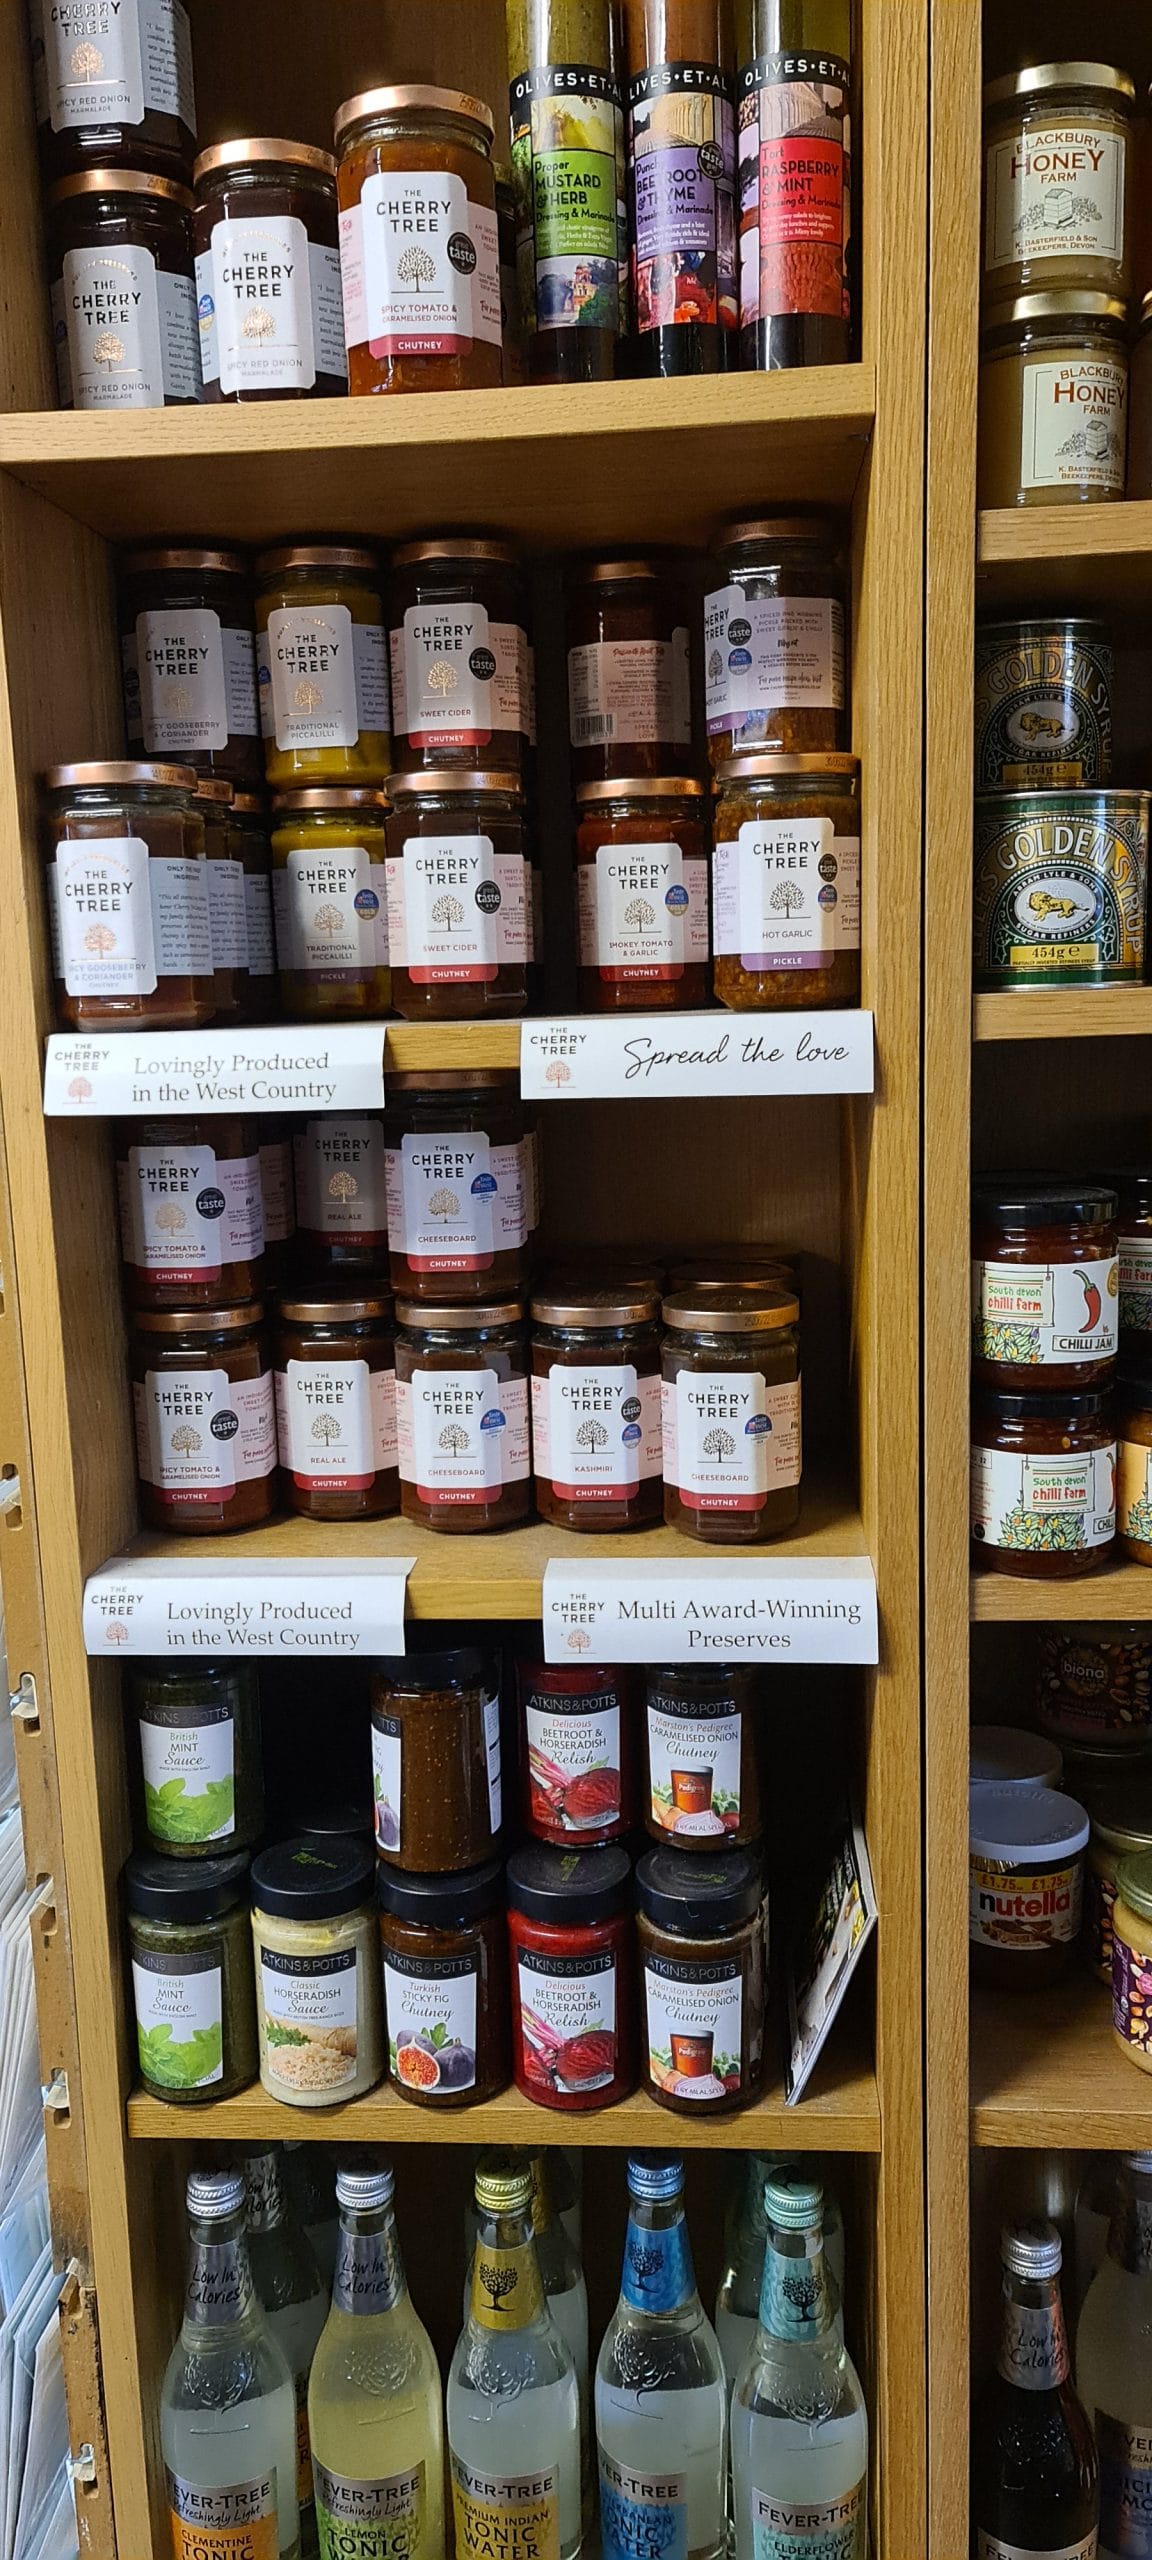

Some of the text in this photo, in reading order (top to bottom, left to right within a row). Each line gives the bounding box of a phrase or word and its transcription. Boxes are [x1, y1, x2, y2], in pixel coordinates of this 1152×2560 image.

[51, 1, 121, 22] CHERRY
[61, 20, 109, 37] TREE
[1017, 132, 1101, 154] BLACKBURY
[535, 161, 569, 175] Proper
[1011, 149, 1105, 179] HONEY
[535, 174, 601, 192] MUSTARD
[1041, 172, 1077, 184] FARM
[777, 178, 813, 192] MINT
[551, 191, 588, 205] HERB
[377, 201, 451, 216] CHERRY
[391, 219, 438, 232] TREE
[244, 253, 268, 262] THE
[450, 246, 476, 264] taste
[223, 265, 294, 283] CHERRY
[93, 280, 117, 290] THE
[235, 284, 281, 298] TREE
[73, 292, 141, 309] CHERRY
[85, 310, 129, 325] TREE
[102, 383, 151, 392] RED ONION
[1054, 382, 1125, 409] HONEY
[1083, 405, 1111, 416] FARM
[471, 660, 495, 670] taste
[987, 650, 1094, 695] GOLDEN
[286, 722, 340, 731] TRADITIONAL
[291, 731, 335, 739] PICCALILLI
[753, 840, 821, 855] CHERRY
[997, 826, 1114, 871] GOLDEN
[416, 858, 479, 871] CHERRY
[765, 856, 808, 870] TREE
[426, 873, 468, 885] TREE
[1043, 871, 1066, 879] LYLE
[65, 882, 133, 897] CHERRY
[476, 892, 500, 904] taste
[76, 900, 121, 913] TREE
[1110, 857, 1142, 954] SYRUP
[762, 930, 813, 939] HOT GARLIC
[306, 944, 357, 952] TRADITIONAL
[423, 944, 478, 952] SWEET CIDER
[609, 940, 674, 949] SMOKEY TOMATO
[312, 953, 353, 961] PICCALILLI
[630, 949, 659, 957] GARLIC
[1032, 946, 1065, 959] 454g
[773, 957, 803, 965] PICKLE
[431, 970, 471, 978] CHUTNEY
[623, 969, 660, 977] CHUTNEY
[530, 1034, 587, 1045] CHERRY
[54, 1051, 110, 1061] CHERRY
[541, 1046, 577, 1056] TREE
[623, 1031, 849, 1080] Spread the love
[64, 1061, 100, 1071] TREE
[134, 1052, 330, 1079] Lovingly Produced
[132, 1081, 337, 1103] in the West Country
[418, 1235, 477, 1243] CHEESEBOARD
[988, 1285, 1041, 1297] South devon
[988, 1296, 1041, 1311] chilli farm
[1059, 1337, 1113, 1349] CHILLI JAM
[562, 1387, 623, 1398] CHERRY
[572, 1400, 612, 1411] TREE
[428, 1469, 486, 1477] CHEESEBOARD
[1033, 1487, 1086, 1500] chilli farm
[91, 1595, 144, 1605] CHERRY
[101, 1606, 134, 1616] TREE
[167, 1602, 352, 1624] Lovingly Produced
[552, 1602, 605, 1612] CHERRY
[618, 1599, 861, 1625] Multi Award-Winning
[562, 1613, 596, 1623] TREE
[167, 1629, 360, 1650] in the West Country
[688, 1629, 791, 1648] Preserves
[1064, 1660, 1104, 1678] biona
[170, 1732, 198, 1741] British
[542, 1728, 593, 1739] BEETROOT
[707, 1731, 738, 1743] ONION
[171, 1743, 198, 1752] MINT
[540, 1738, 606, 1750] HORSERADISH
[164, 1752, 205, 1766] Sauce
[552, 1750, 596, 1765] Relish
[980, 1890, 1070, 1917] nutella
[290, 1979, 320, 1990] Classic
[409, 1982, 441, 1993] Turkish
[546, 1979, 586, 1990] Delicious
[274, 1987, 341, 2001] HORSERADISH
[402, 1990, 449, 2003] STICKY FIG
[535, 1988, 588, 2001] BEETROOT
[288, 2000, 329, 2014] Sauce
[401, 2000, 455, 2022] Chutney
[533, 1998, 601, 2012] HORSERADISH
[665, 2005, 721, 2026] Chutney
[343, 2255, 386, 2274] Low In
[338, 2272, 390, 2294] Calories
[385, 2499, 410, 2517] Light
[505, 2510, 549, 2526] INDIAN
[345, 2528, 386, 2539] LEMON
[465, 2511, 535, 2543] TONIC
[181, 2529, 252, 2548] CLEMENTINE
[328, 2527, 407, 2557] TONIC
[464, 2527, 540, 2559] WATER
